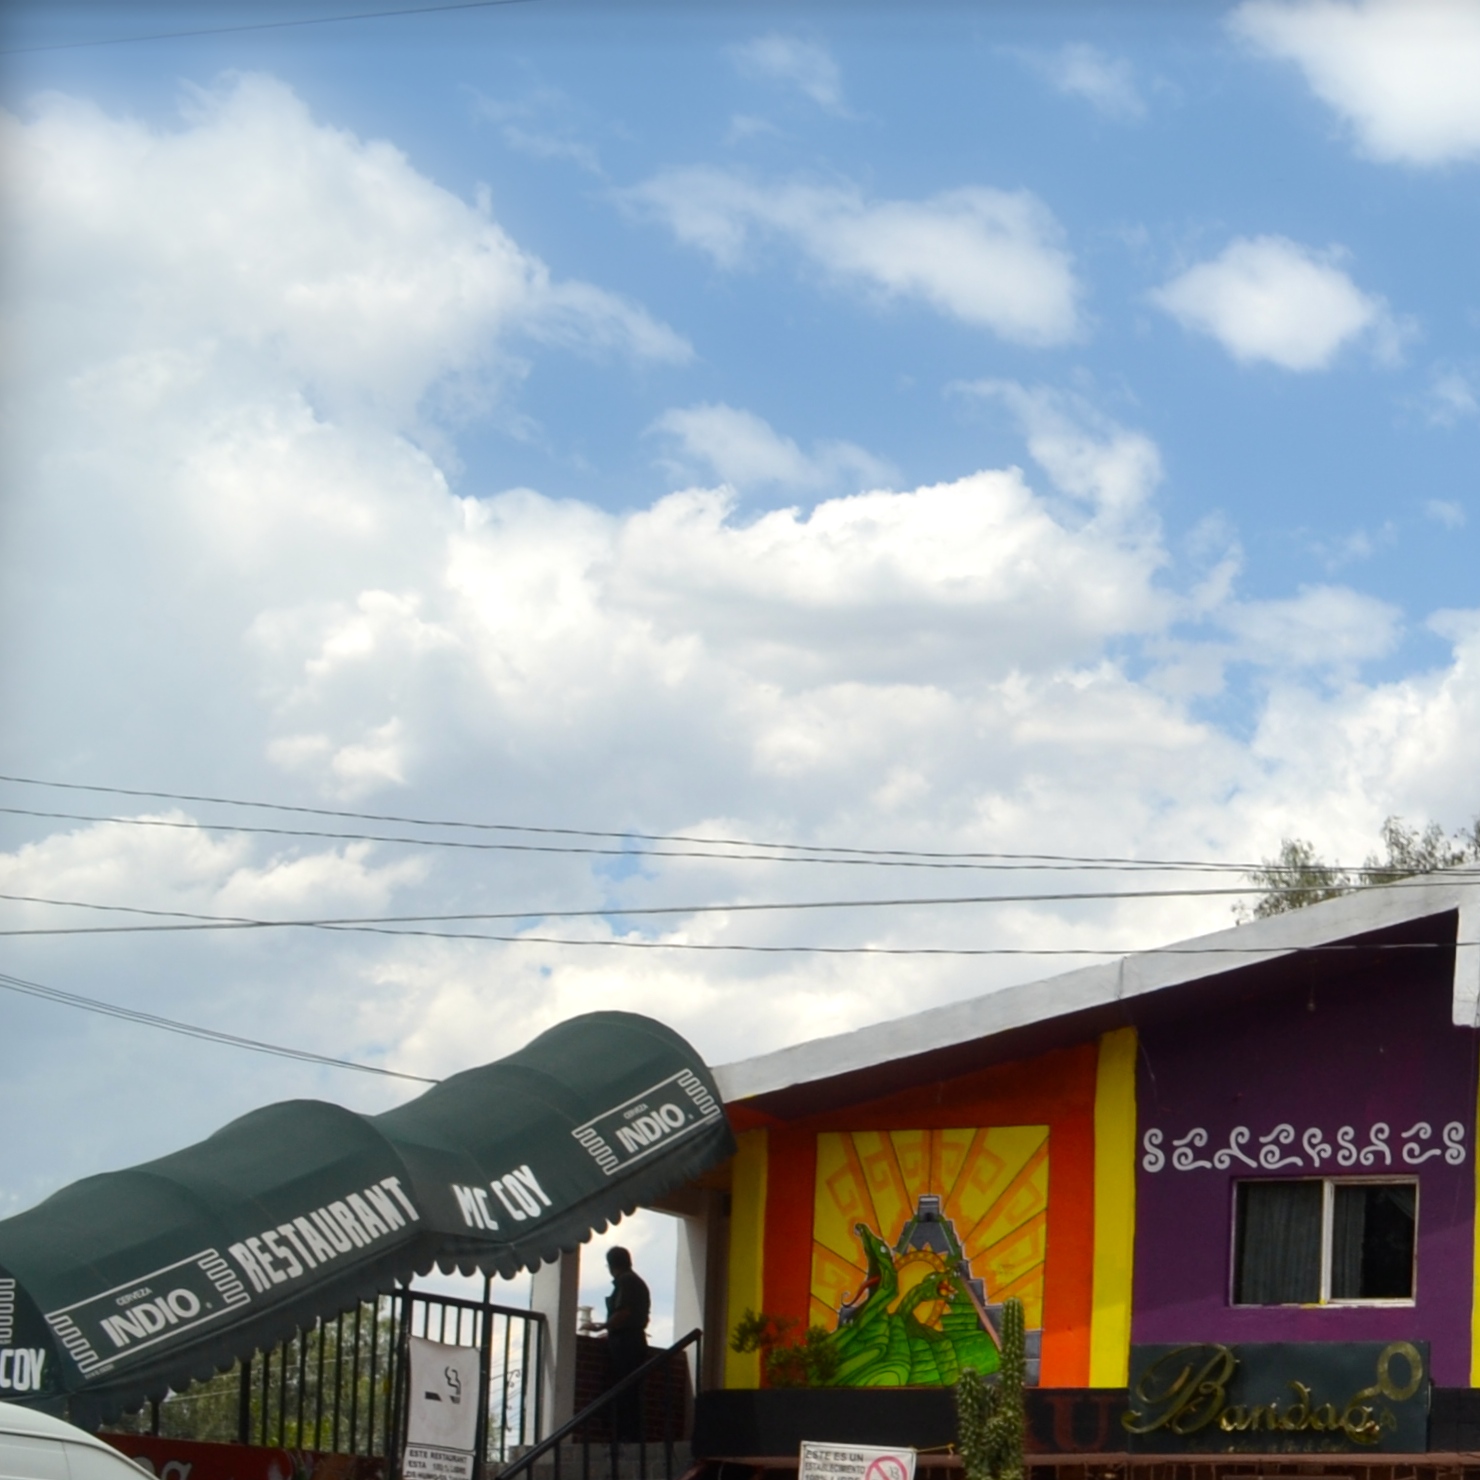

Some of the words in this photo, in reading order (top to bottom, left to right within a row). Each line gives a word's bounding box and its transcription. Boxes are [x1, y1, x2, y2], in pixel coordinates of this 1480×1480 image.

[615, 1103, 685, 1153] INDIO
[228, 1176, 420, 1293] RESTAURANT
[452, 1184, 499, 1230] MC
[490, 1165, 552, 1221] COY
[116, 1287, 152, 1306] CERVEZA
[100, 1288, 200, 1347] INDIO
[0, 1348, 45, 1391] COY
[409, 1449, 428, 1458] ESTE
[805, 1462, 866, 1474] ESTABLECIMIENTO
[806, 1450, 831, 1460] ESTE
[834, 1451, 846, 1461] ES
[849, 1453, 863, 1462] UN
